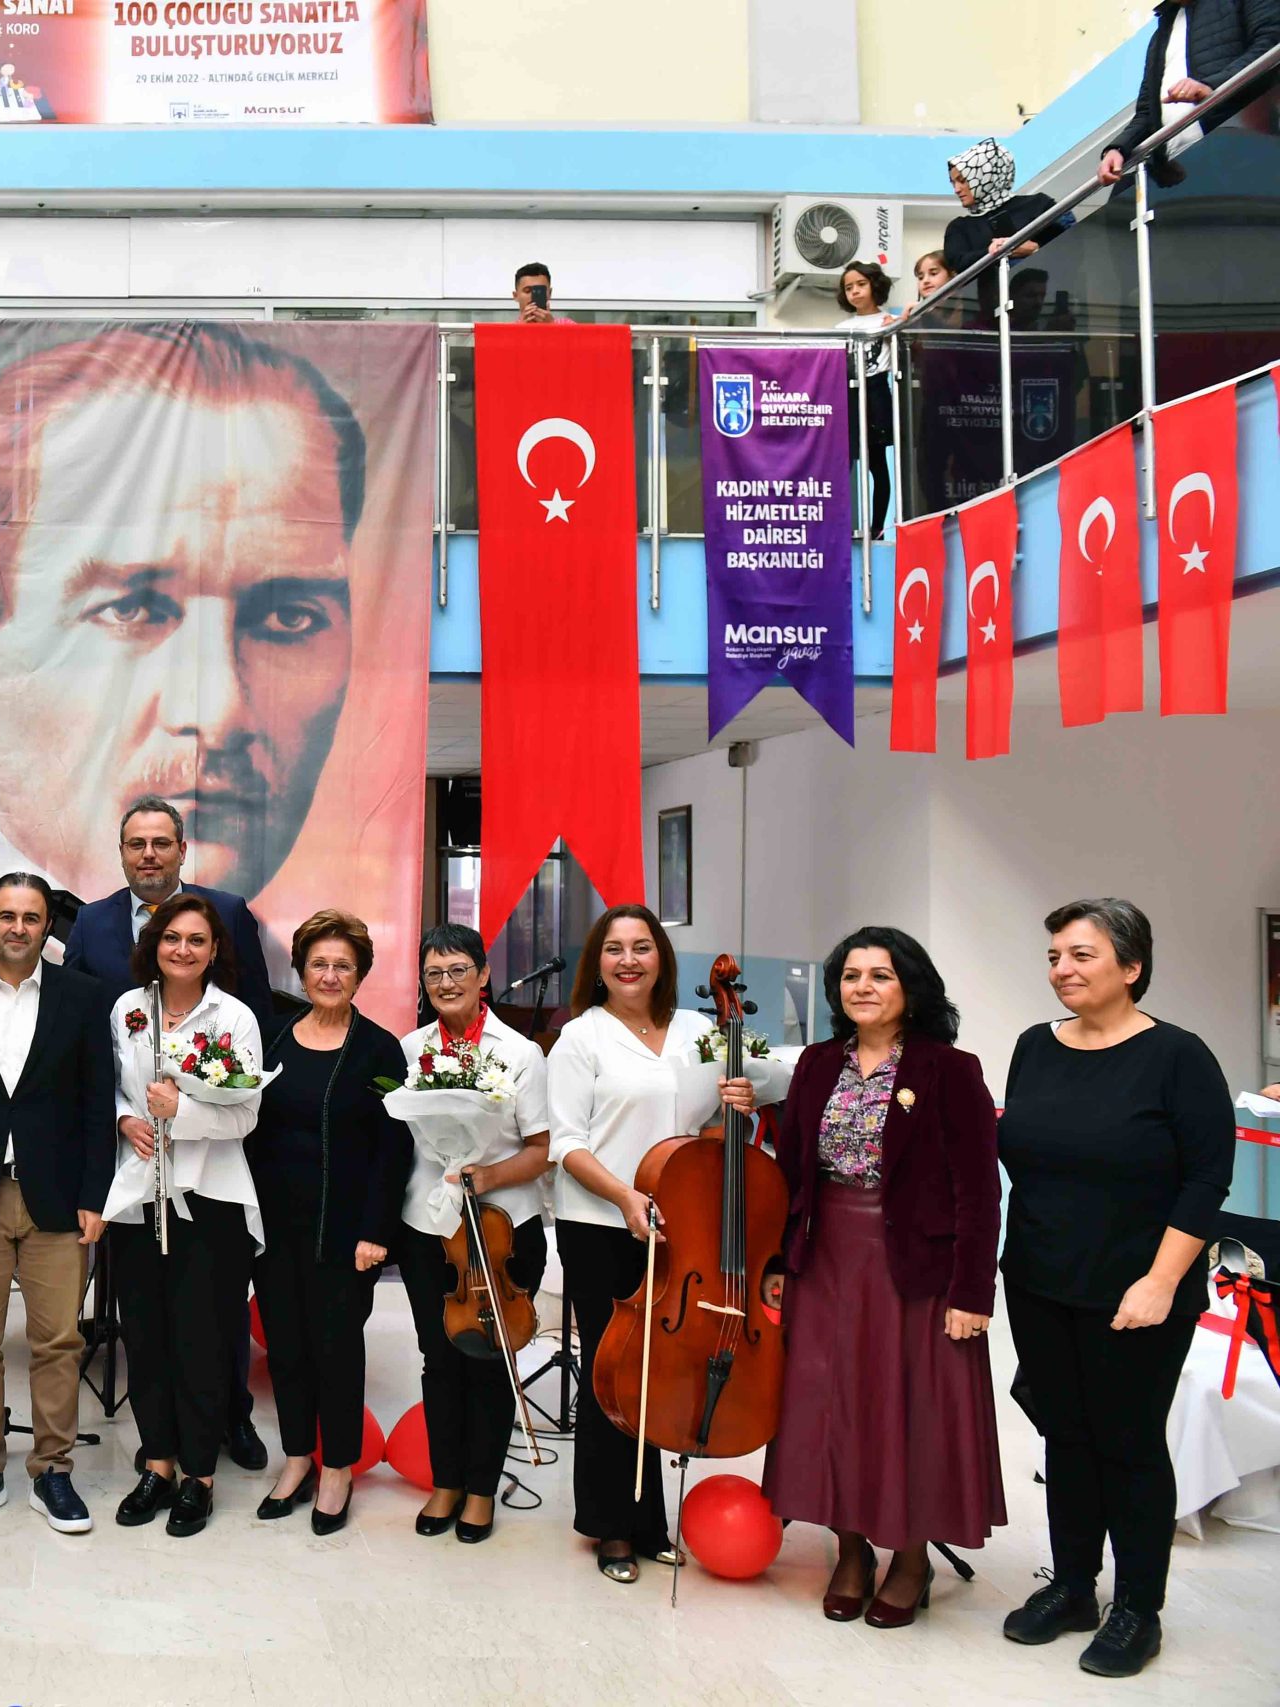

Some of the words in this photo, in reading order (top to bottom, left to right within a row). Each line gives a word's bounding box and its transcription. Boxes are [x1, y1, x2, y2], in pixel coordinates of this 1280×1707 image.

[114, 2, 158, 26] 100
[259, 1, 360, 24] SANATLA
[6, 22, 40, 35] KORO
[131, 32, 344, 60] BULUŞTURUYORUZ
[135, 74, 147, 84] 29
[150, 72, 174, 83] EKİM
[176, 74, 199, 83] 2022
[208, 71, 254, 83] ALTINDAĞ
[256, 70, 295, 83] GENÇLİK
[297, 69, 339, 81] MERKEZİ
[244, 106, 306, 114] Mansur
[876, 206, 891, 251] arçelik
[760, 381, 781, 391] T.C.
[760, 392, 810, 403] ANKARA
[716, 480, 769, 497] KADIN
[773, 480, 794, 497] VE
[797, 477, 832, 498] AİLE
[725, 500, 824, 522] HİZMETLERİ
[743, 524, 807, 545] DAİRESİ
[727, 548, 824, 571] BAŞKANLIĞI
[724, 623, 828, 645] Mansur
